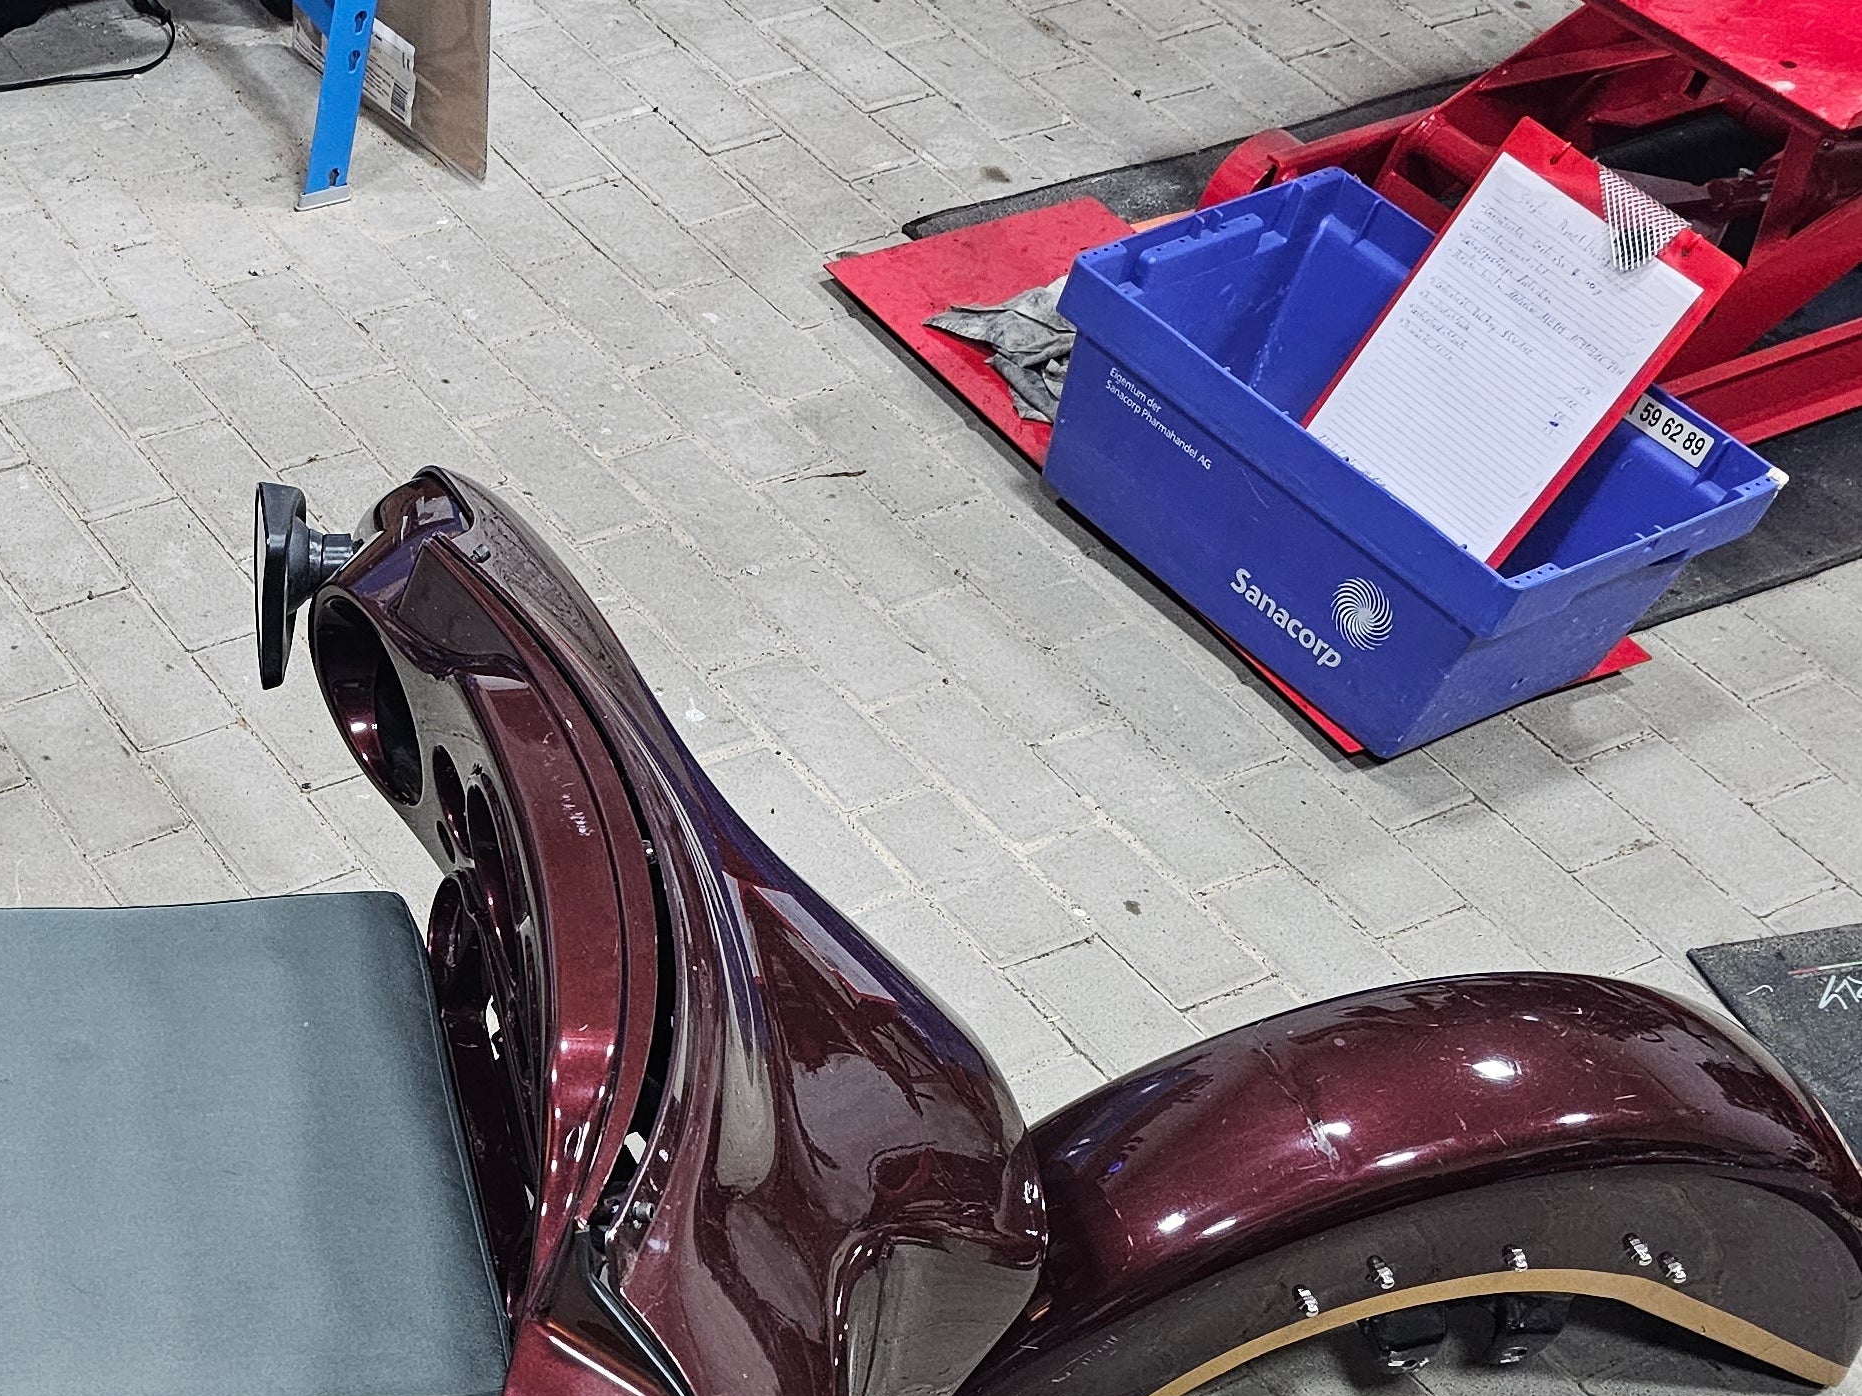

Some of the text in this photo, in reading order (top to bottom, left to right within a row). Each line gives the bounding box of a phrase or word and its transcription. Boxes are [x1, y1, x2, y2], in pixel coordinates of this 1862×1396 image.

[1105, 380, 1213, 470] Sanacorp Pharmahandel AG
[1109, 367, 1162, 413] Eigentum der
[1640, 402, 1662, 428] 59
[1661, 417, 1684, 443] 62
[1682, 431, 1706, 456] 89
[1230, 567, 1342, 668] Sanacorp
